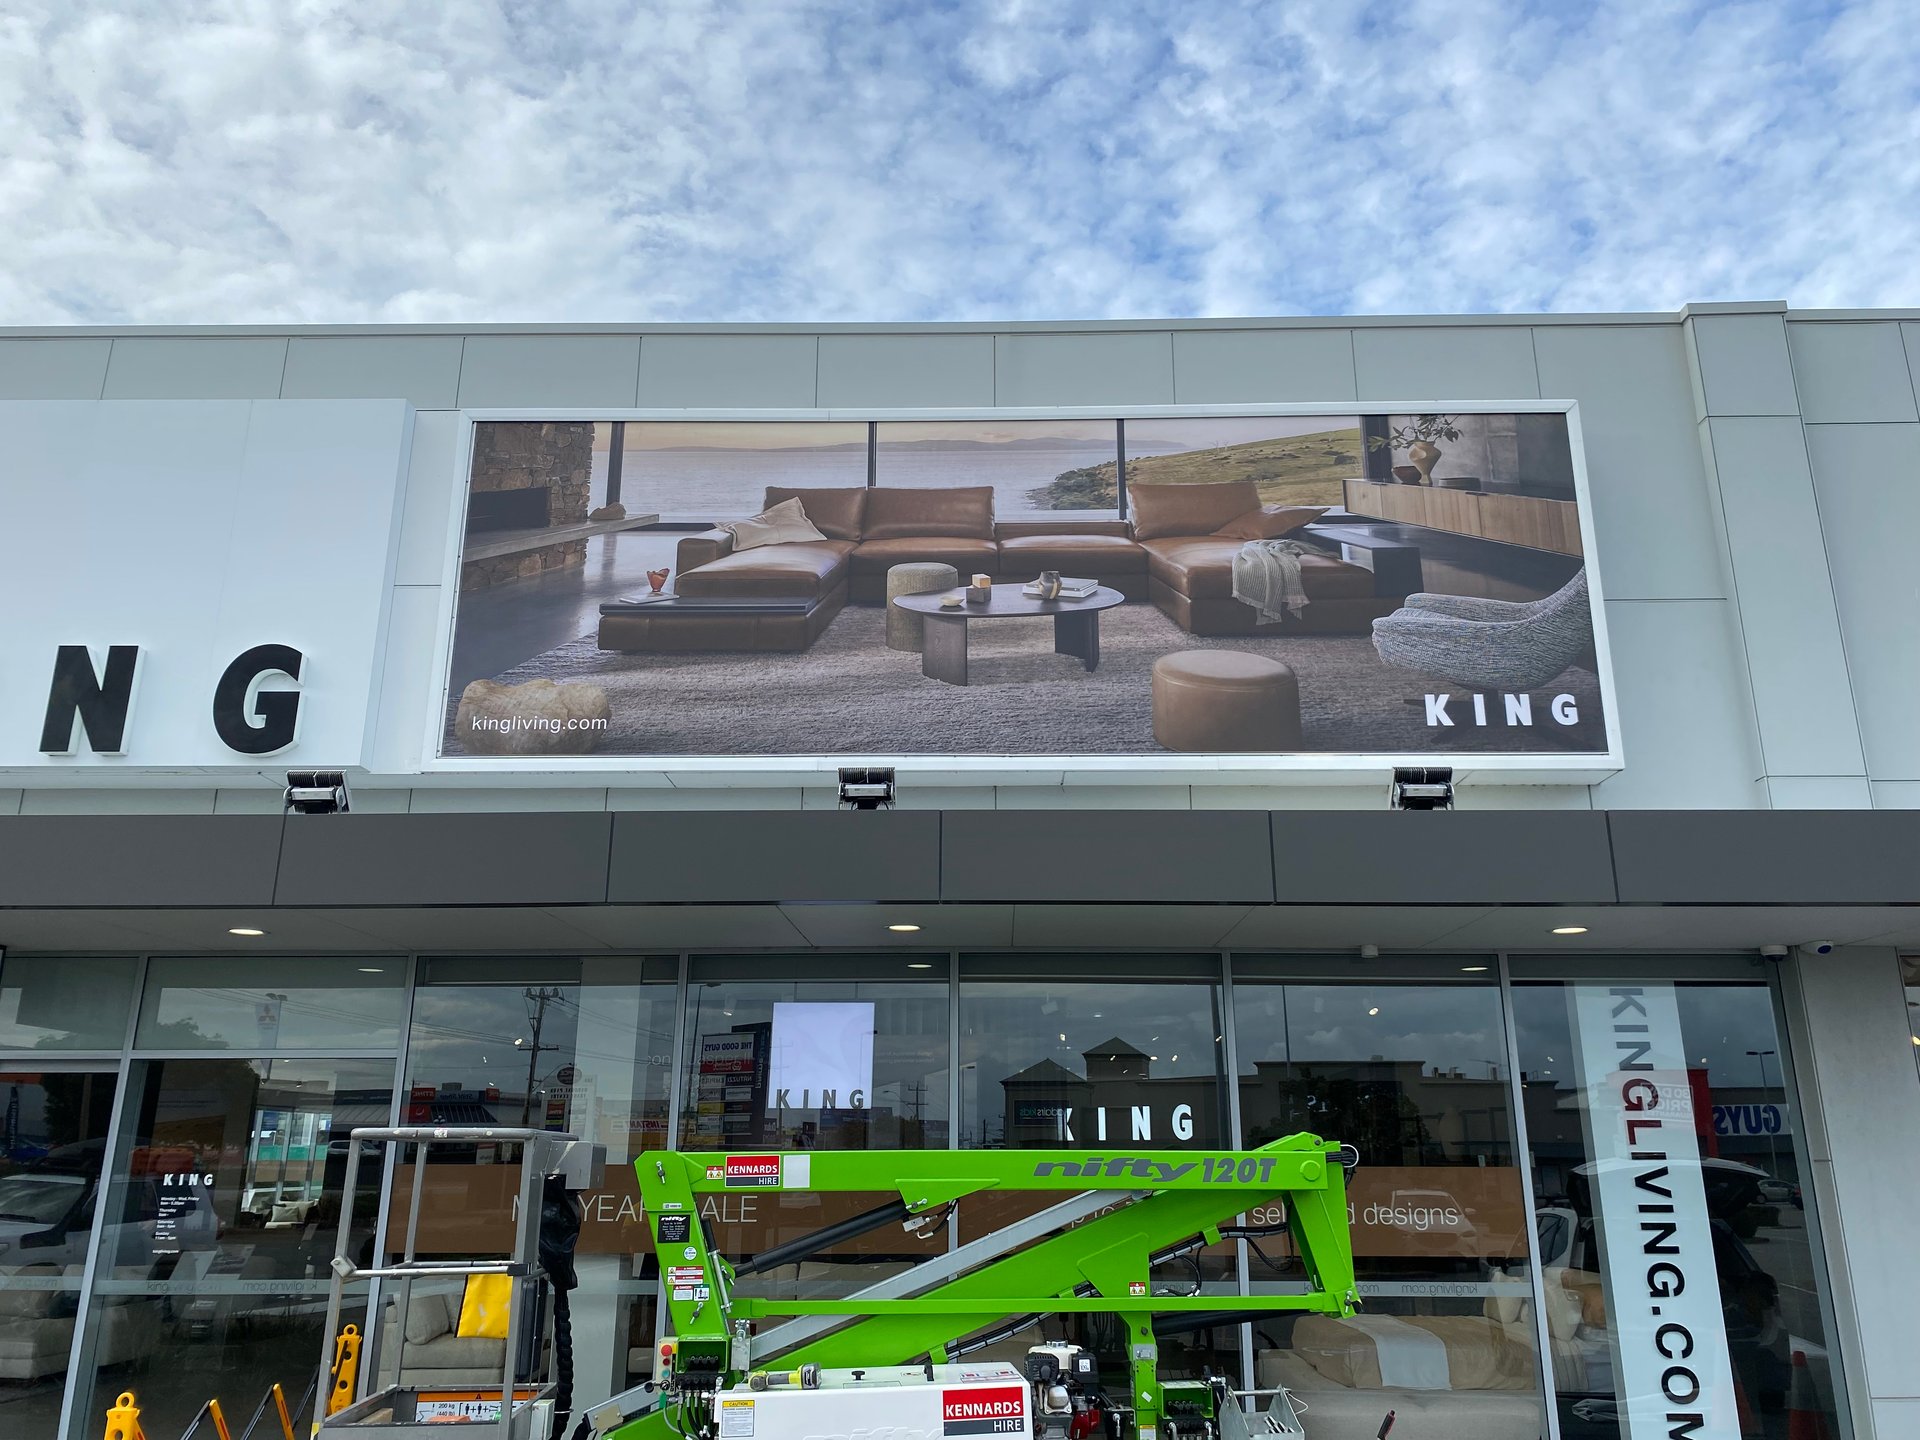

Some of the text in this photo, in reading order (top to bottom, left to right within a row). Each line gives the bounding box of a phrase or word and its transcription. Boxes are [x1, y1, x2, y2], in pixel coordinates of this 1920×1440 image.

[1424, 693, 1579, 726] KING
[472, 716, 607, 734] kingliving.com
[776, 1089, 864, 1109] KING
[1057, 1103, 1193, 1140] KING
[727, 1165, 778, 1174] KENNARDS
[1034, 1157, 1277, 1183] nifty 120T
[163, 1173, 214, 1186] KING
[758, 1177, 778, 1185] HIRE
[700, 1195, 758, 1223] ALE
[1363, 1202, 1459, 1231] designs
[945, 1401, 1021, 1417] KENNARDS
[993, 1419, 1021, 1432] HIRE
